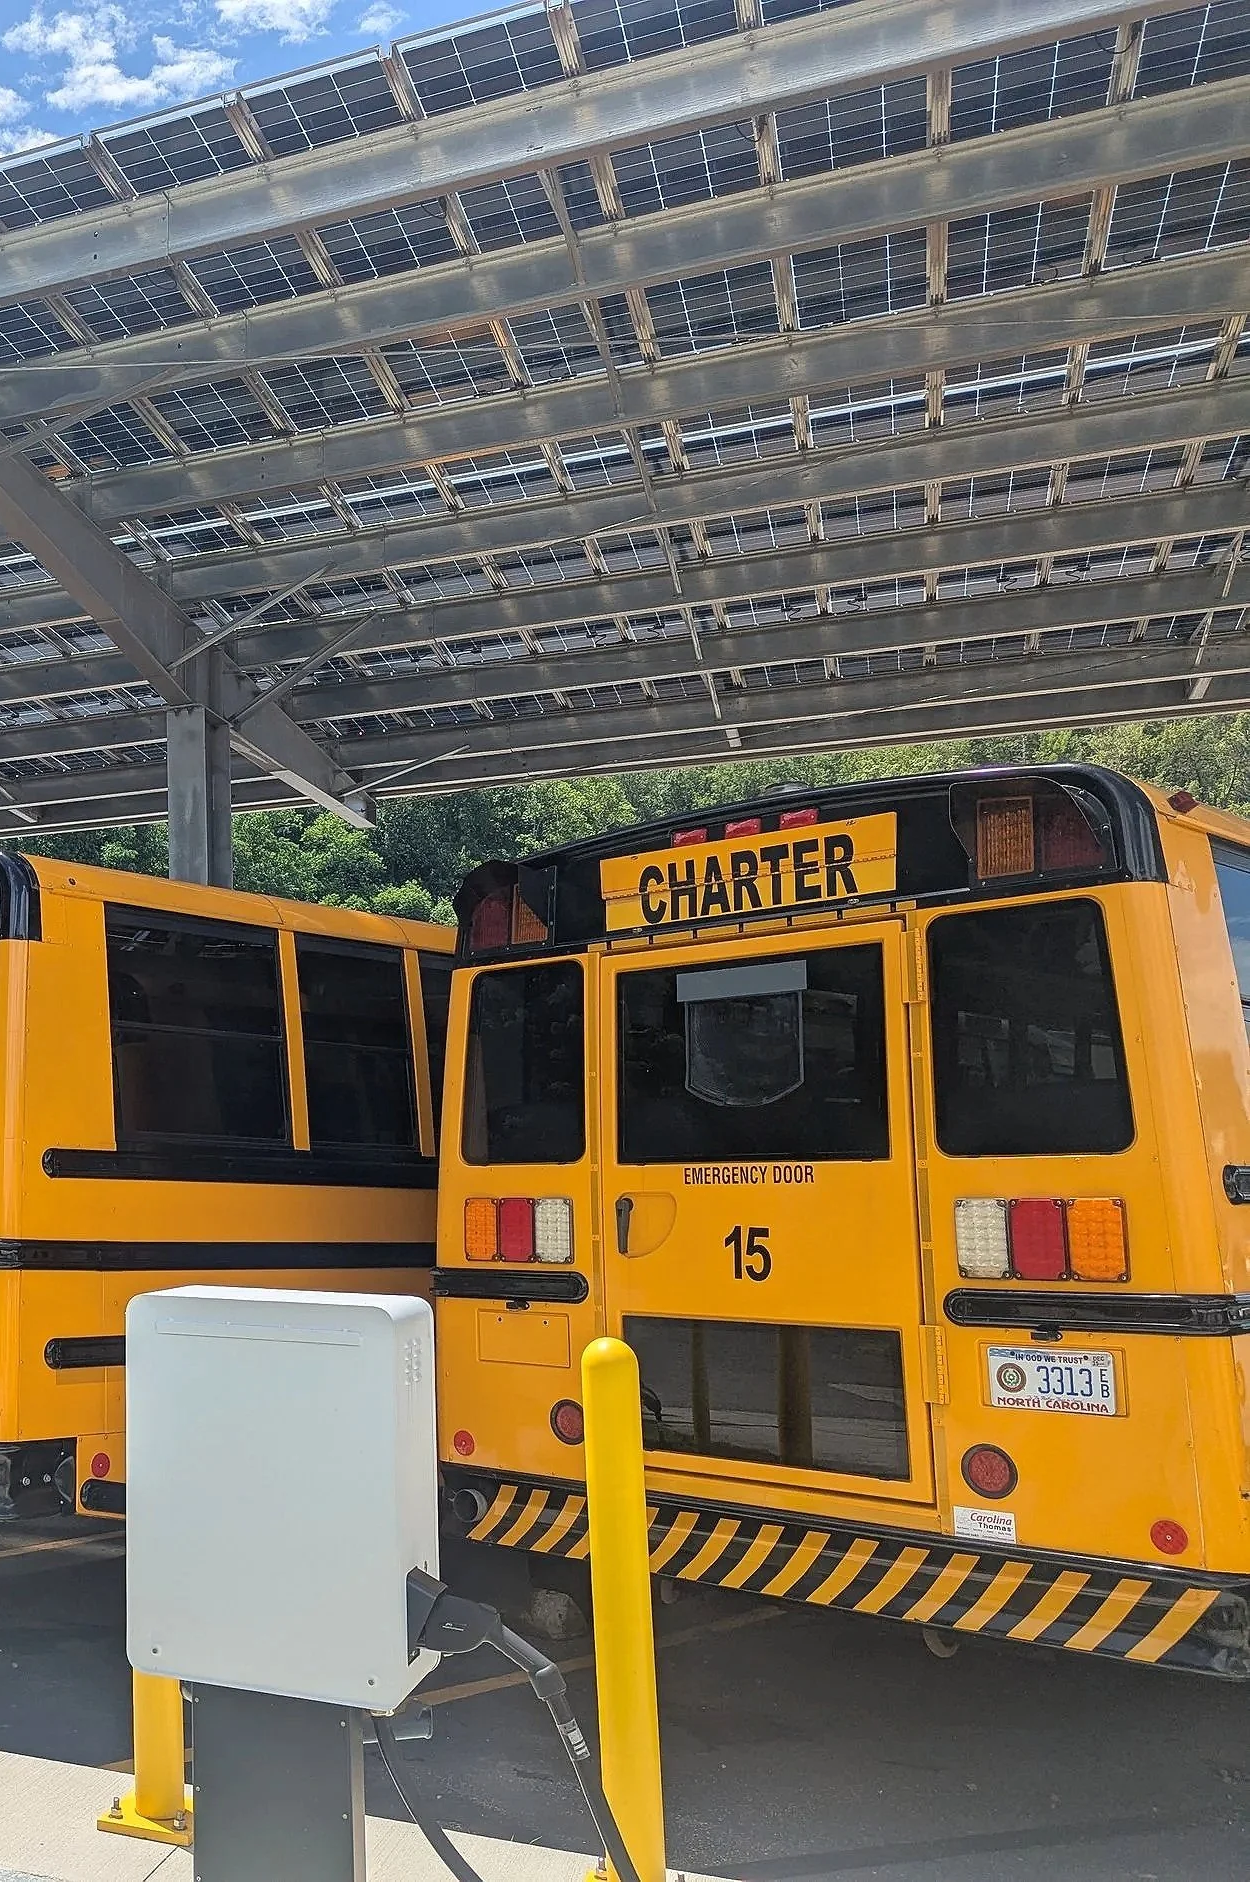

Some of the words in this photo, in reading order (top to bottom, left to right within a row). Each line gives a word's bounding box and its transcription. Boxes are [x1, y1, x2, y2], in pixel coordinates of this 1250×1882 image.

[638, 834, 859, 925] CHARTER
[684, 1166, 767, 1185] EMERGENCY
[773, 1165, 815, 1184] DOOR
[724, 1225, 772, 1282] 15
[1015, 1353, 1025, 1361] IN
[1026, 1354, 1042, 1362] GOD
[1043, 1355, 1056, 1363] WE
[1057, 1356, 1084, 1364] TRUST
[1036, 1365, 1094, 1397] 3313
[997, 1396, 1041, 1408] NORTH
[1045, 1399, 1109, 1413] CAROLINA
[970, 1512, 1012, 1526] Carolina
[978, 1522, 1012, 1532] Thomas
